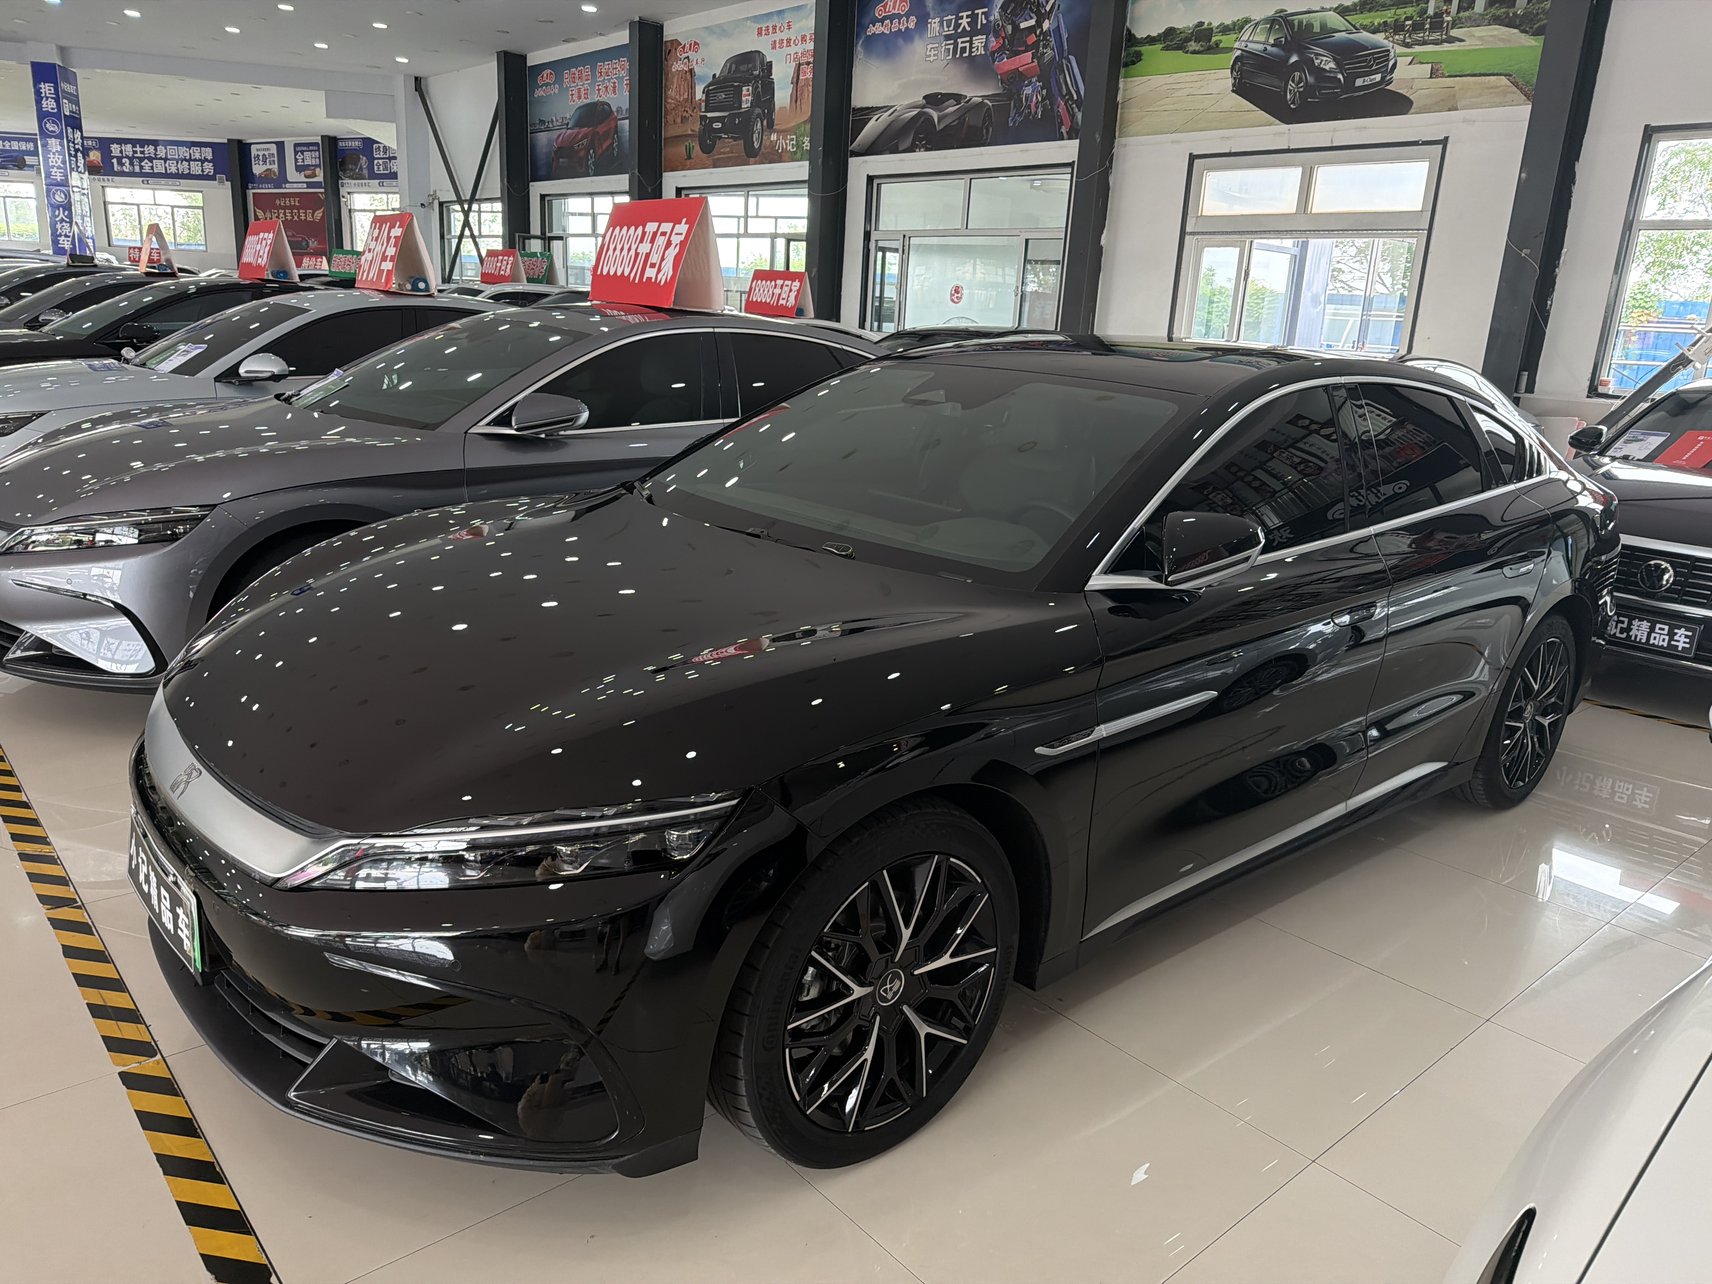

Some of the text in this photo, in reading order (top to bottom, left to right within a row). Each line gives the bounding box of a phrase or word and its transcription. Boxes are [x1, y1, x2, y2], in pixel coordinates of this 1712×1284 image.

[757, 20, 793, 38] 精选放心车
[928, 8, 988, 38] 诚立天下
[771, 32, 815, 51] 请您放心购买
[926, 35, 987, 62] 车行万家
[597, 57, 629, 80] 保证任何
[110, 144, 213, 160] 查博士终身回购保障
[253, 153, 268, 166] 终身
[296, 151, 311, 165] 全国
[39, 82, 72, 250] 拒绝 事故车 火烧车
[129, 248, 160, 262] 特车
[358, 221, 403, 282] 特价车
[597, 217, 689, 286] 18888开回家
[749, 278, 801, 308] 18888开回家
[130, 831, 190, 952] 小记精品车
